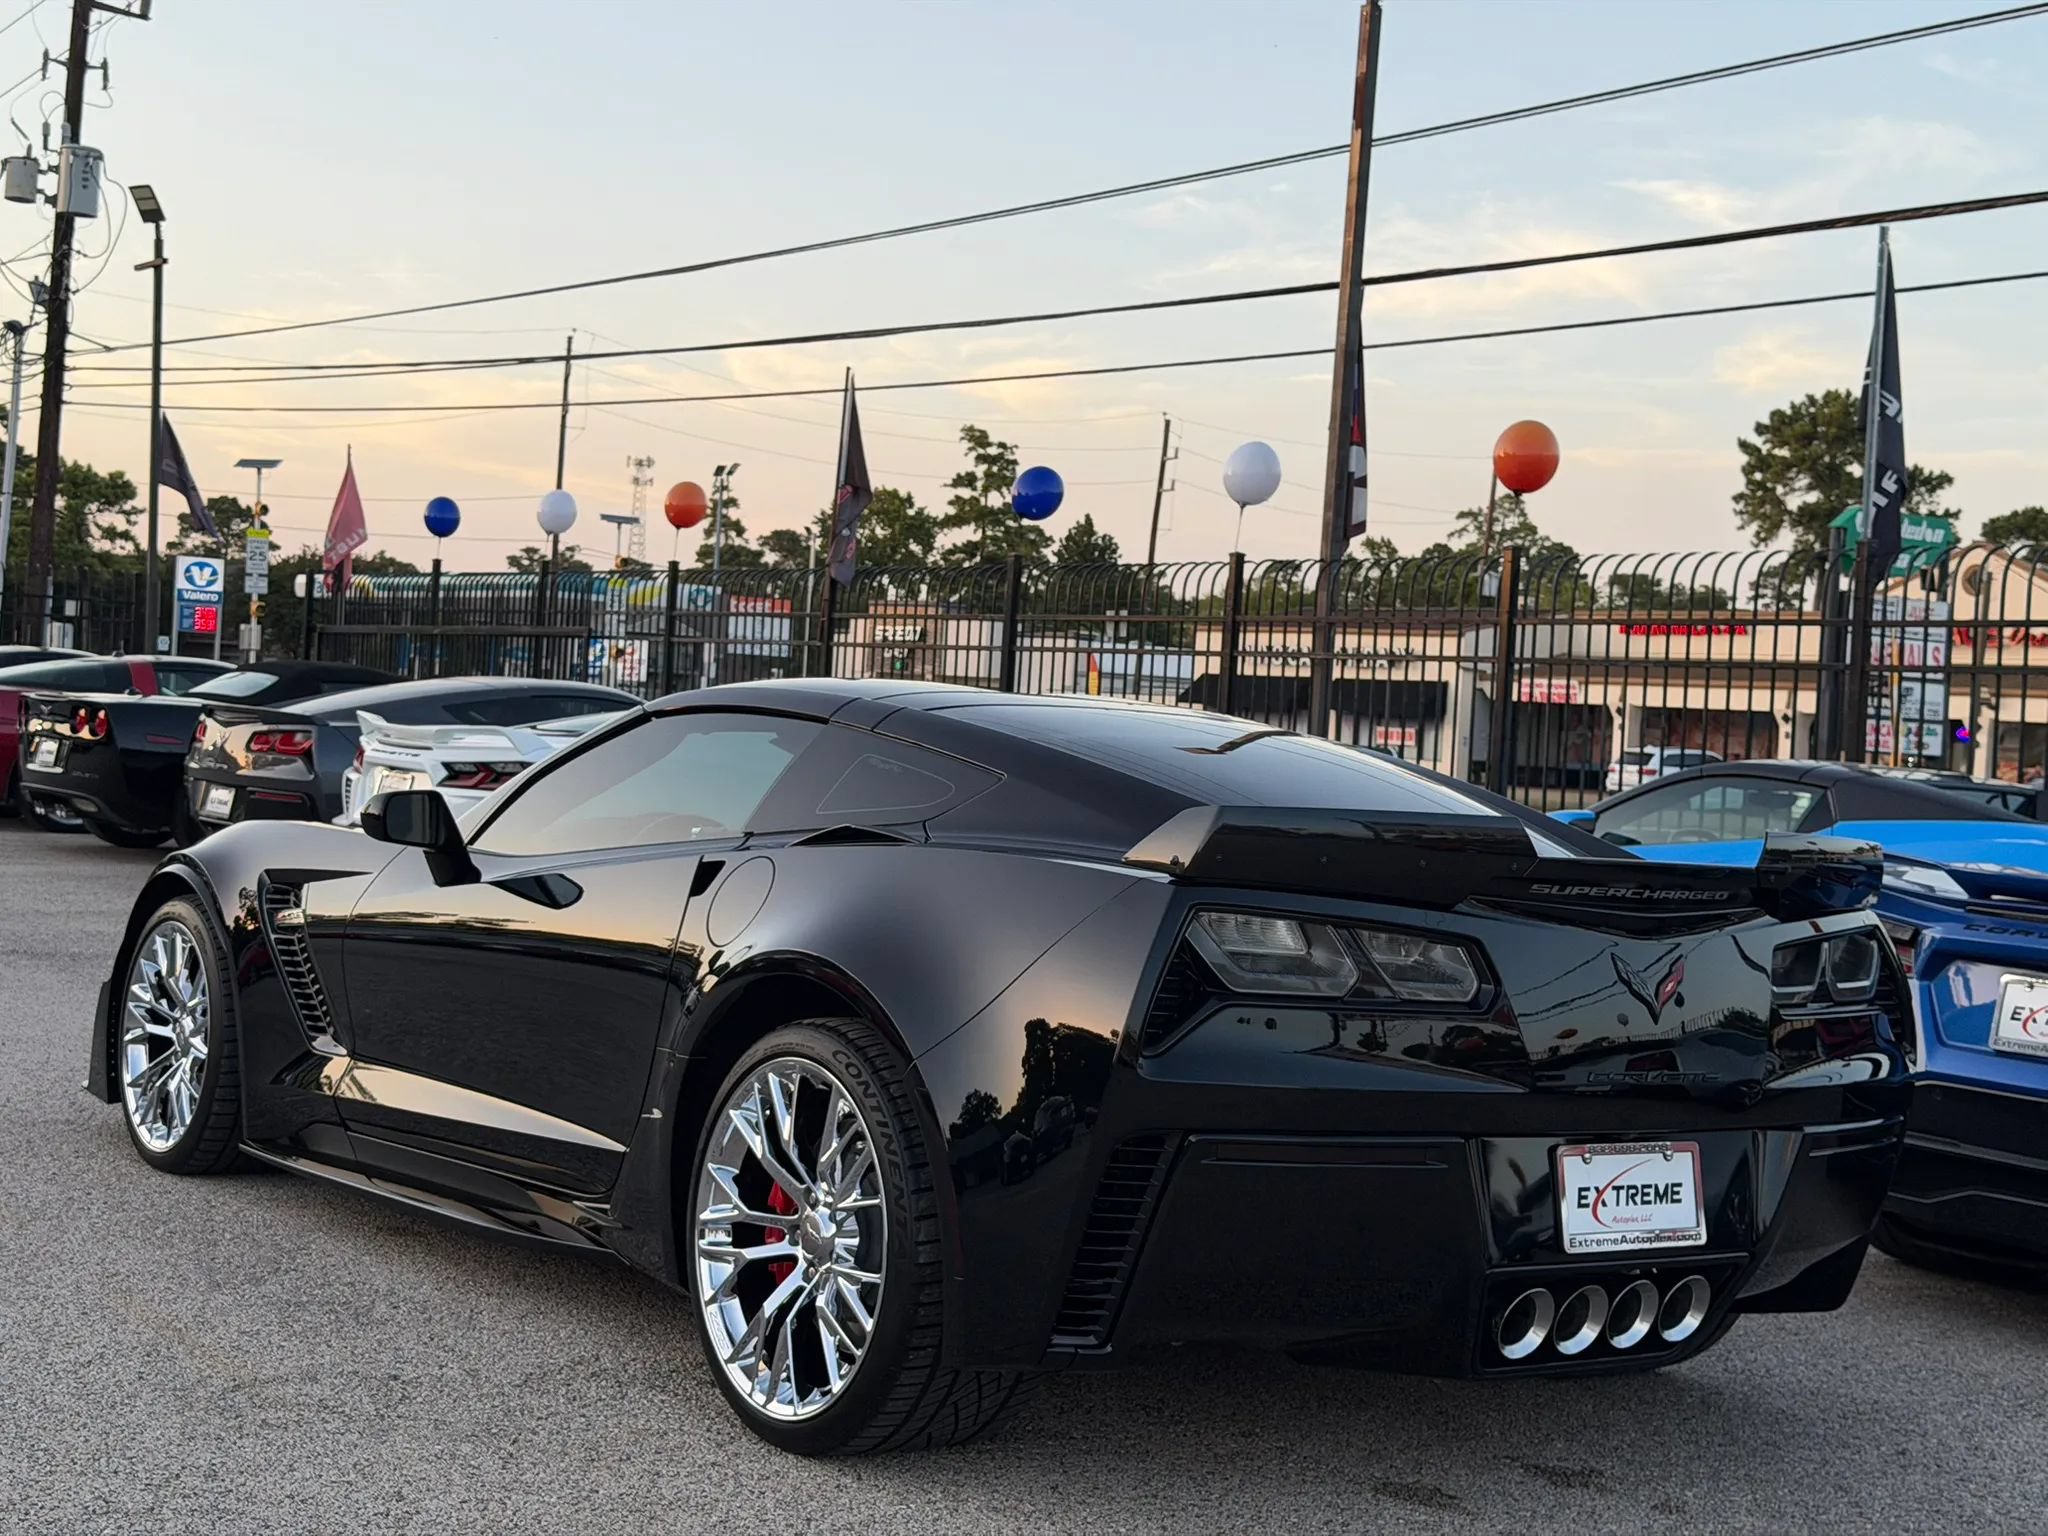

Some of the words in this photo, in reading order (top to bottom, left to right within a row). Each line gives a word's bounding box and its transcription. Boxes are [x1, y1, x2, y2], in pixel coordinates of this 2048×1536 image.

[249, 550, 267, 562] 25
[182, 590, 219, 602] Valero
[1529, 884, 1729, 900] SUPERCHARGED
[1577, 1182, 1683, 1209] EXTREME
